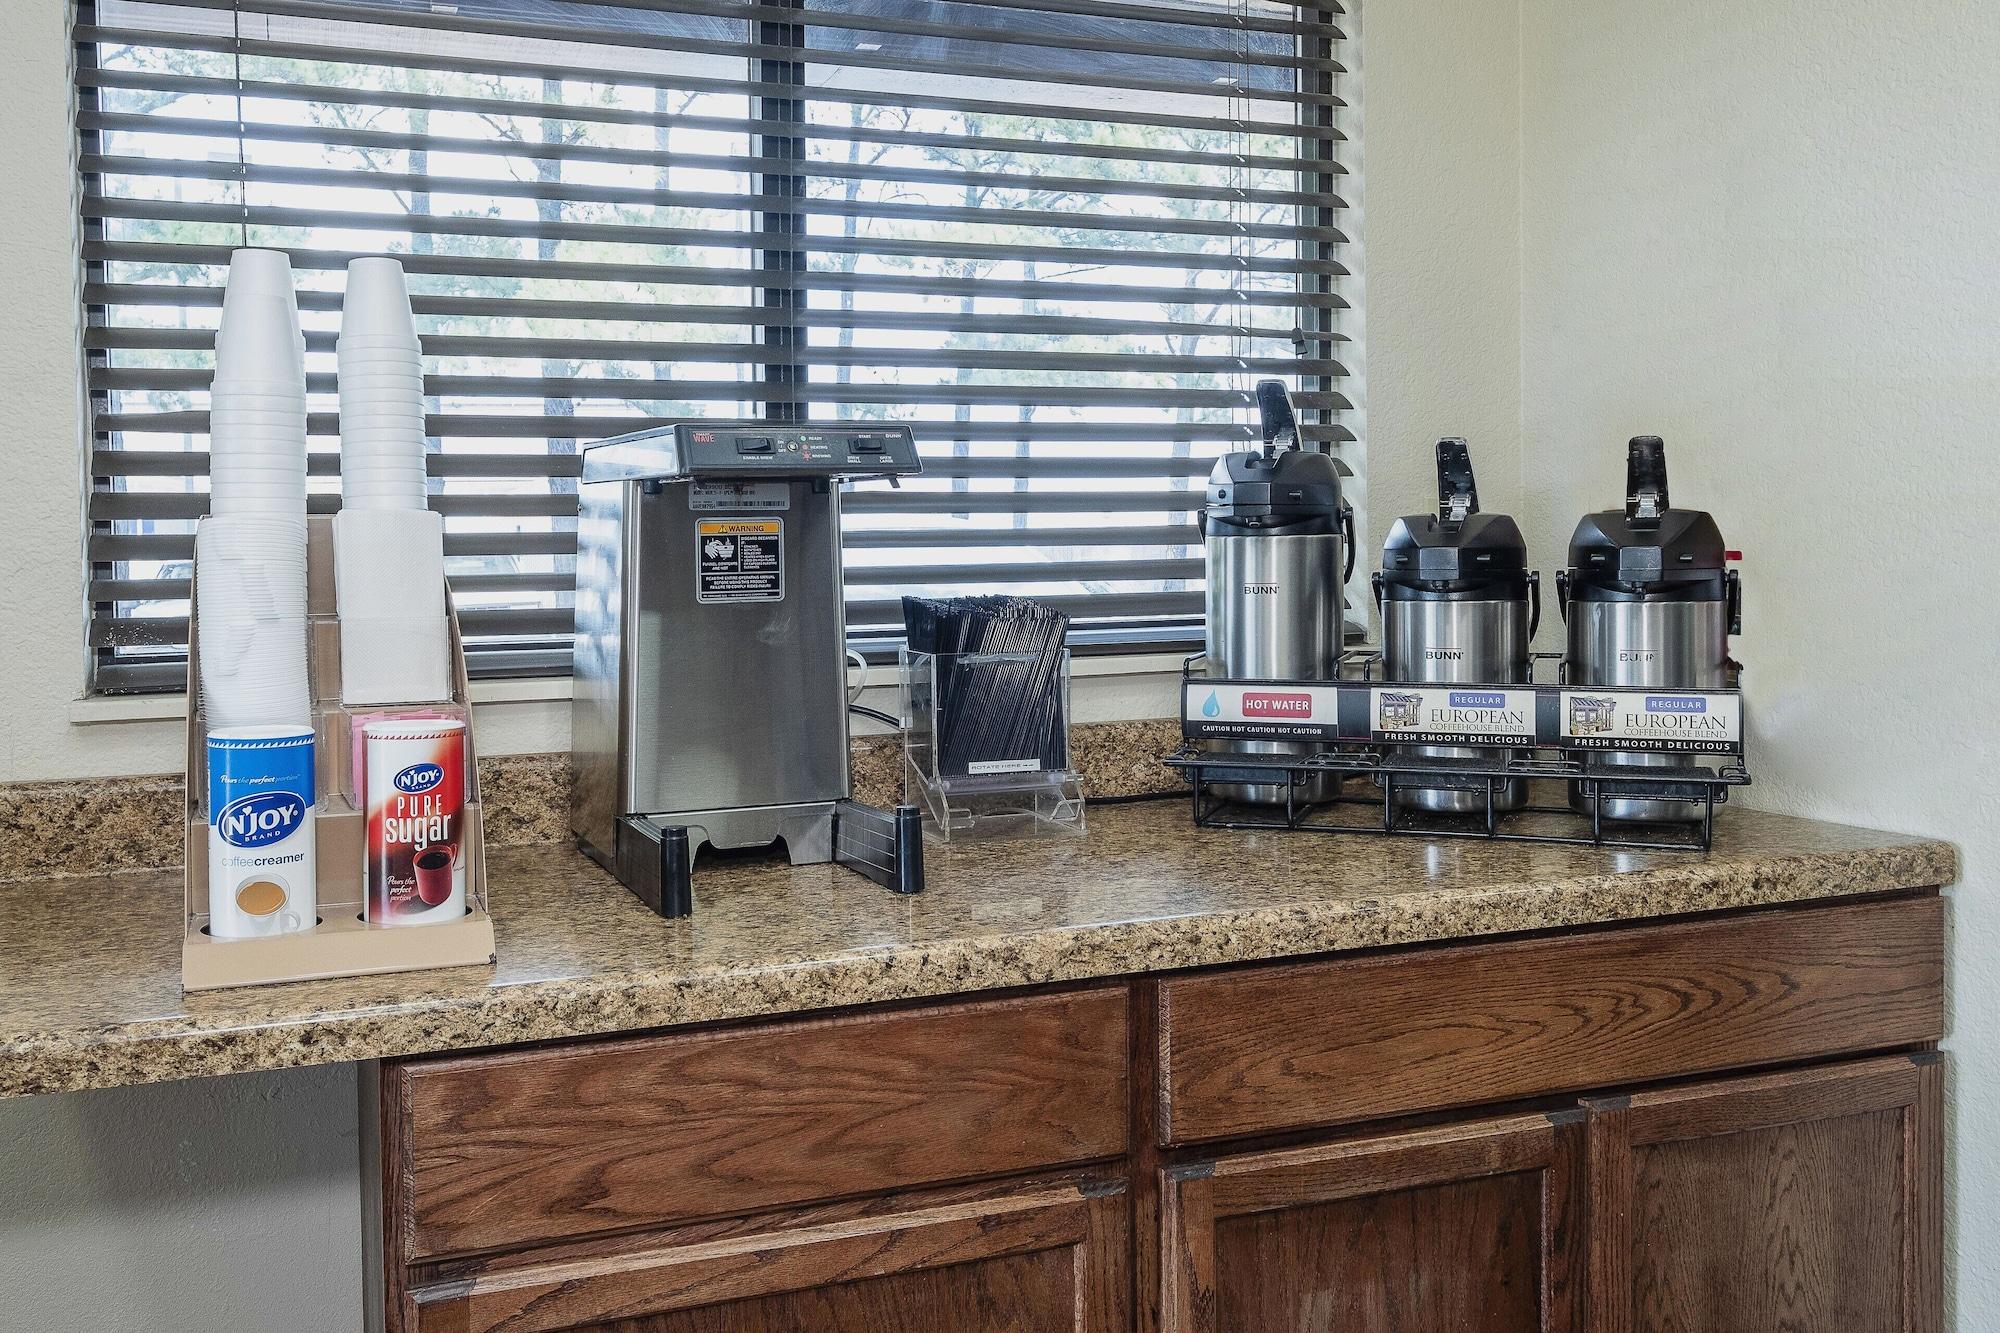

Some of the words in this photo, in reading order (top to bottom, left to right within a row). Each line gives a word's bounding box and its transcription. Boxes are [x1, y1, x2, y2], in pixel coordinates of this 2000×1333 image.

[692, 433, 715, 443] WAVE
[1244, 585, 1278, 595] BUNN
[1425, 651, 1462, 660] BUNN
[1246, 700, 1269, 710] HOT
[1271, 700, 1309, 711] WATER
[1454, 696, 1501, 704] REGULAR
[1651, 700, 1702, 709] REGULAR
[1431, 709, 1524, 724] EUROPEAN
[1625, 713, 1726, 730] EUROPEAN
[1429, 722, 1493, 732] COFFEEHOUSE
[1494, 723, 1525, 733] BLEND
[1384, 732, 1417, 741] FRESH
[1421, 733, 1466, 742] SMOOTH
[1470, 735, 1528, 744] DELICIOUS
[1623, 728, 1693, 738] COFFEEHOUSE
[1694, 730, 1728, 739] BLEND
[1574, 738, 1609, 747] FRESH
[1614, 740, 1662, 749] SMOOTH
[1667, 741, 1731, 750] DELICIOUS
[220, 774, 238, 784] Pours
[248, 774, 276, 785] perfect
[397, 793, 442, 818] PURE
[244, 830, 281, 842] BRAND
[385, 813, 451, 852] sugar
[387, 875, 404, 885] Pours
[389, 885, 412, 896] perfect
